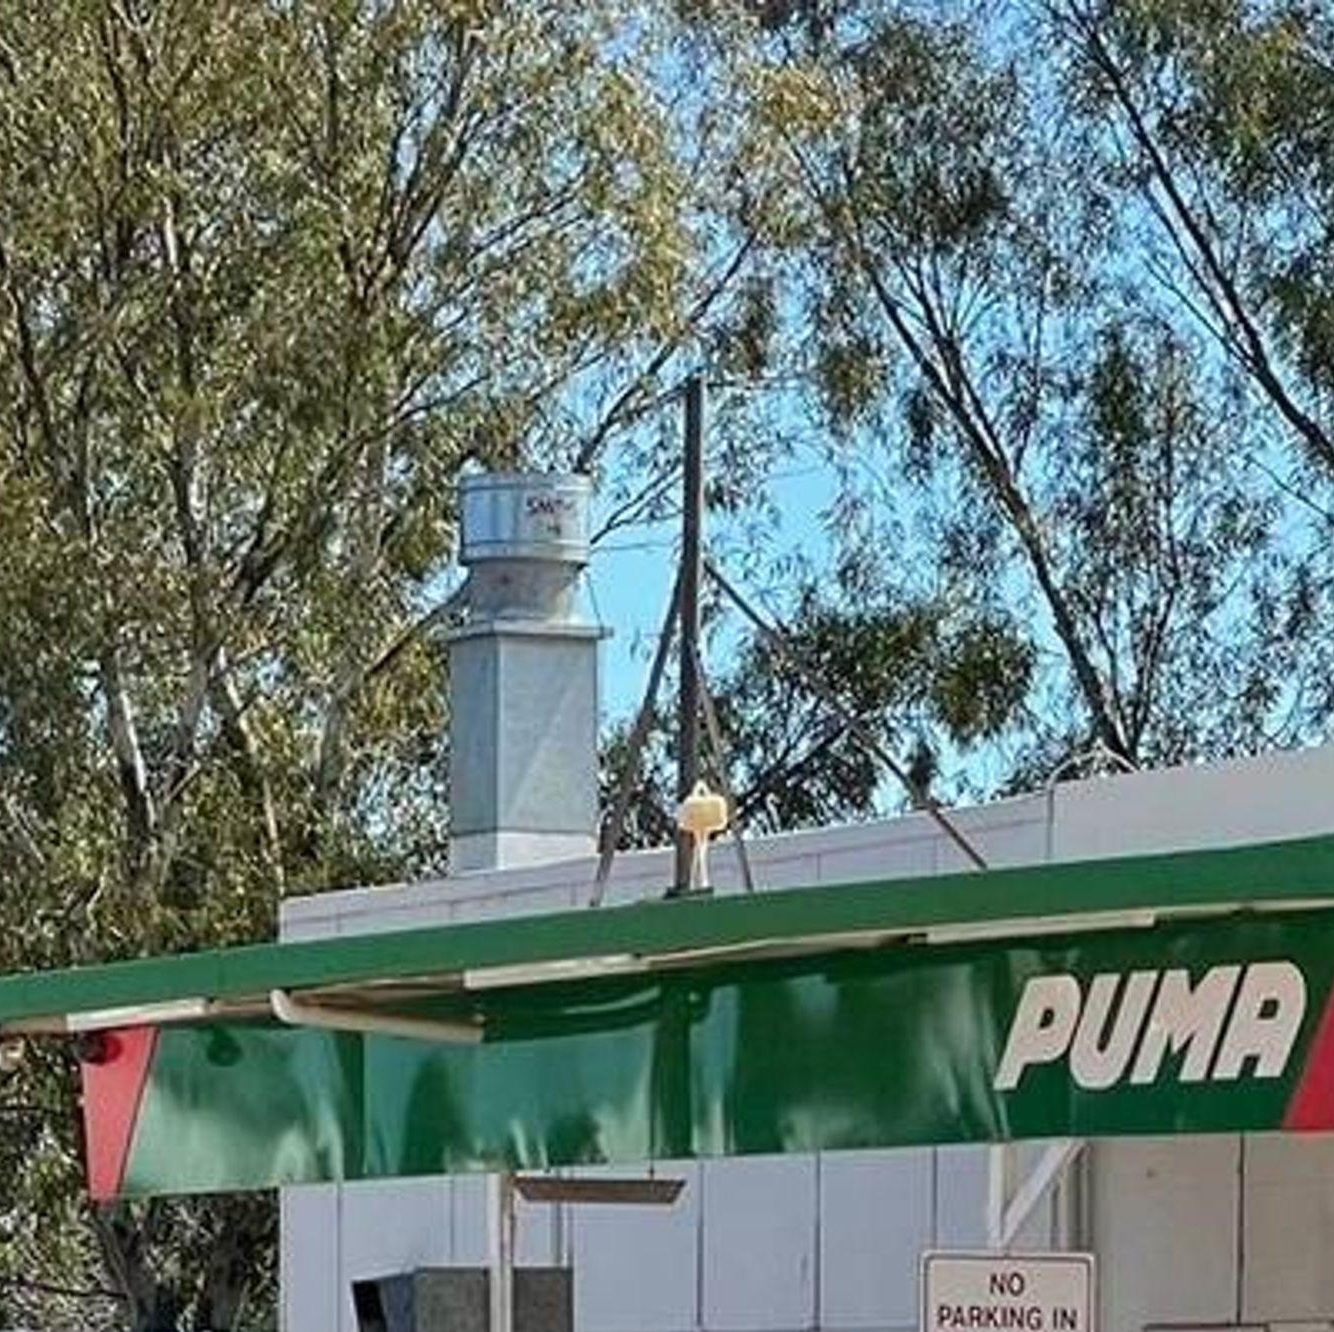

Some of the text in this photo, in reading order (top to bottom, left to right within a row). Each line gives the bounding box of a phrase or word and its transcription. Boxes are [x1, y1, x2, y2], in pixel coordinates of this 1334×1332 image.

[992, 961, 1307, 1091] PUMA
[989, 1272, 1025, 1297] NO
[937, 1305, 1078, 1331] PARKING IN
